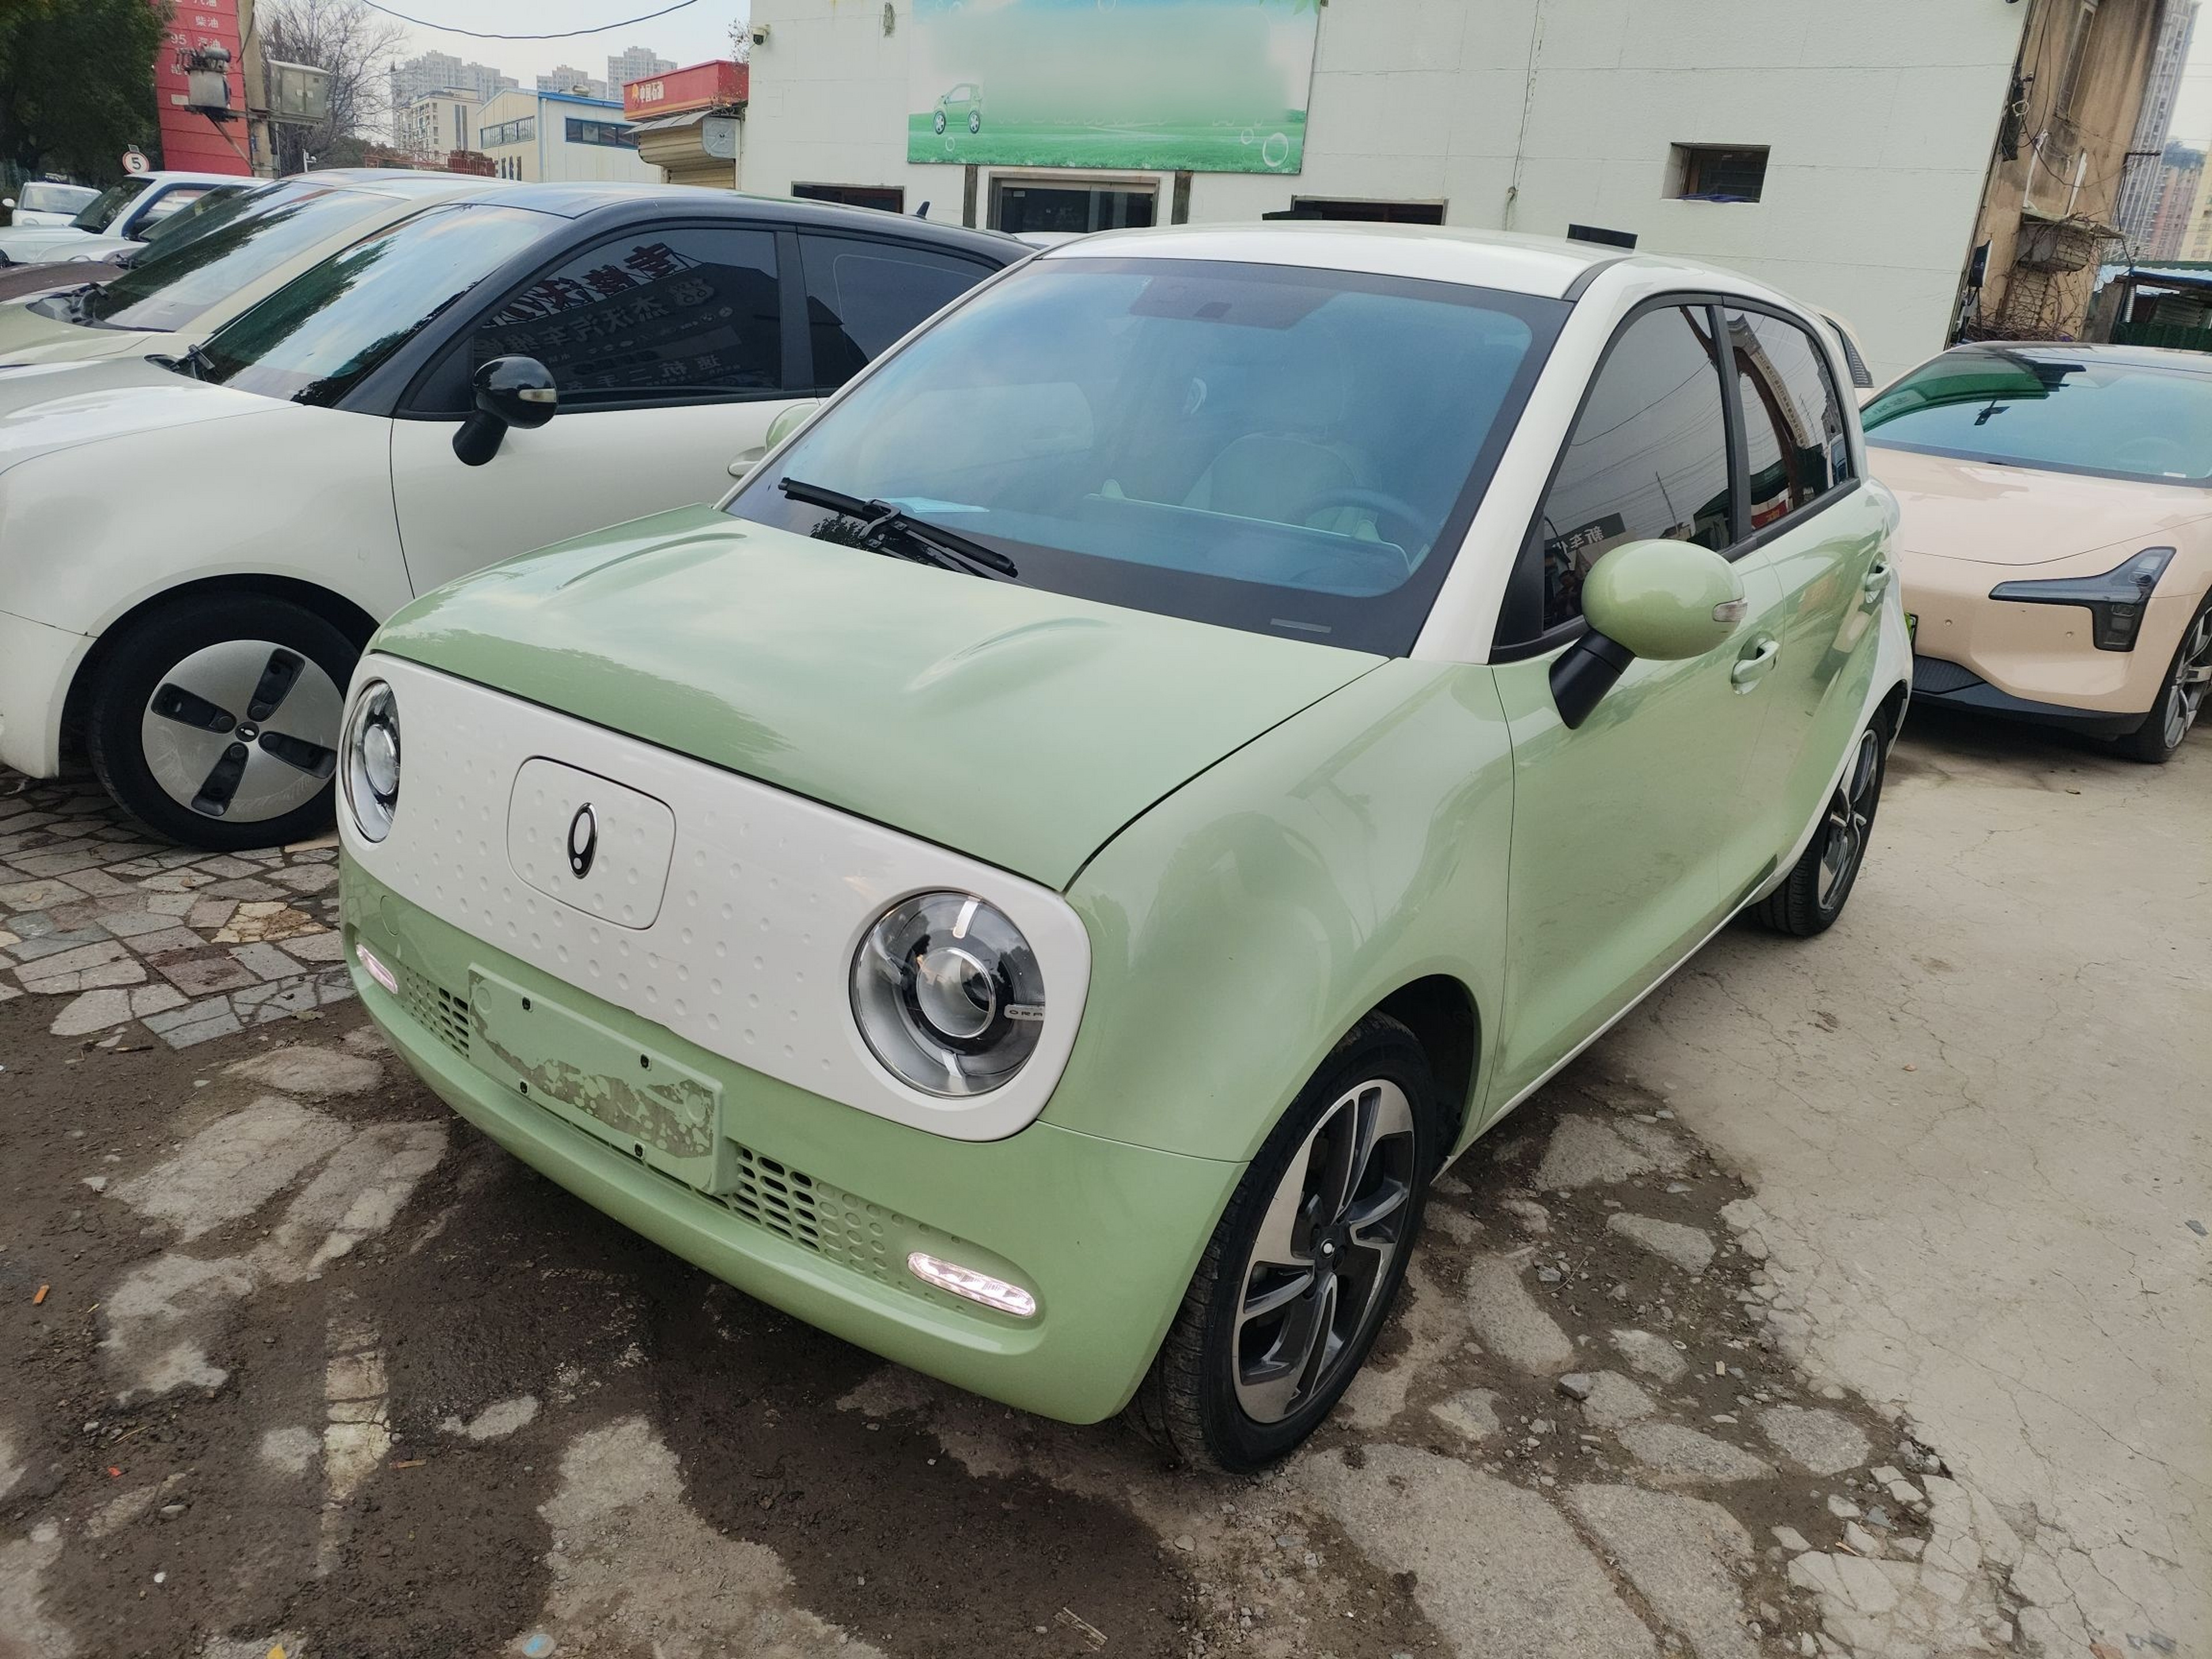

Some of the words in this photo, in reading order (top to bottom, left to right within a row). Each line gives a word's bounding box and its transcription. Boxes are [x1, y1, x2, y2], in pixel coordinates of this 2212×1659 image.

[195, 15, 218, 28] 柴油
[171, 33, 187, 45] 95
[131, 157, 142, 170] 5
